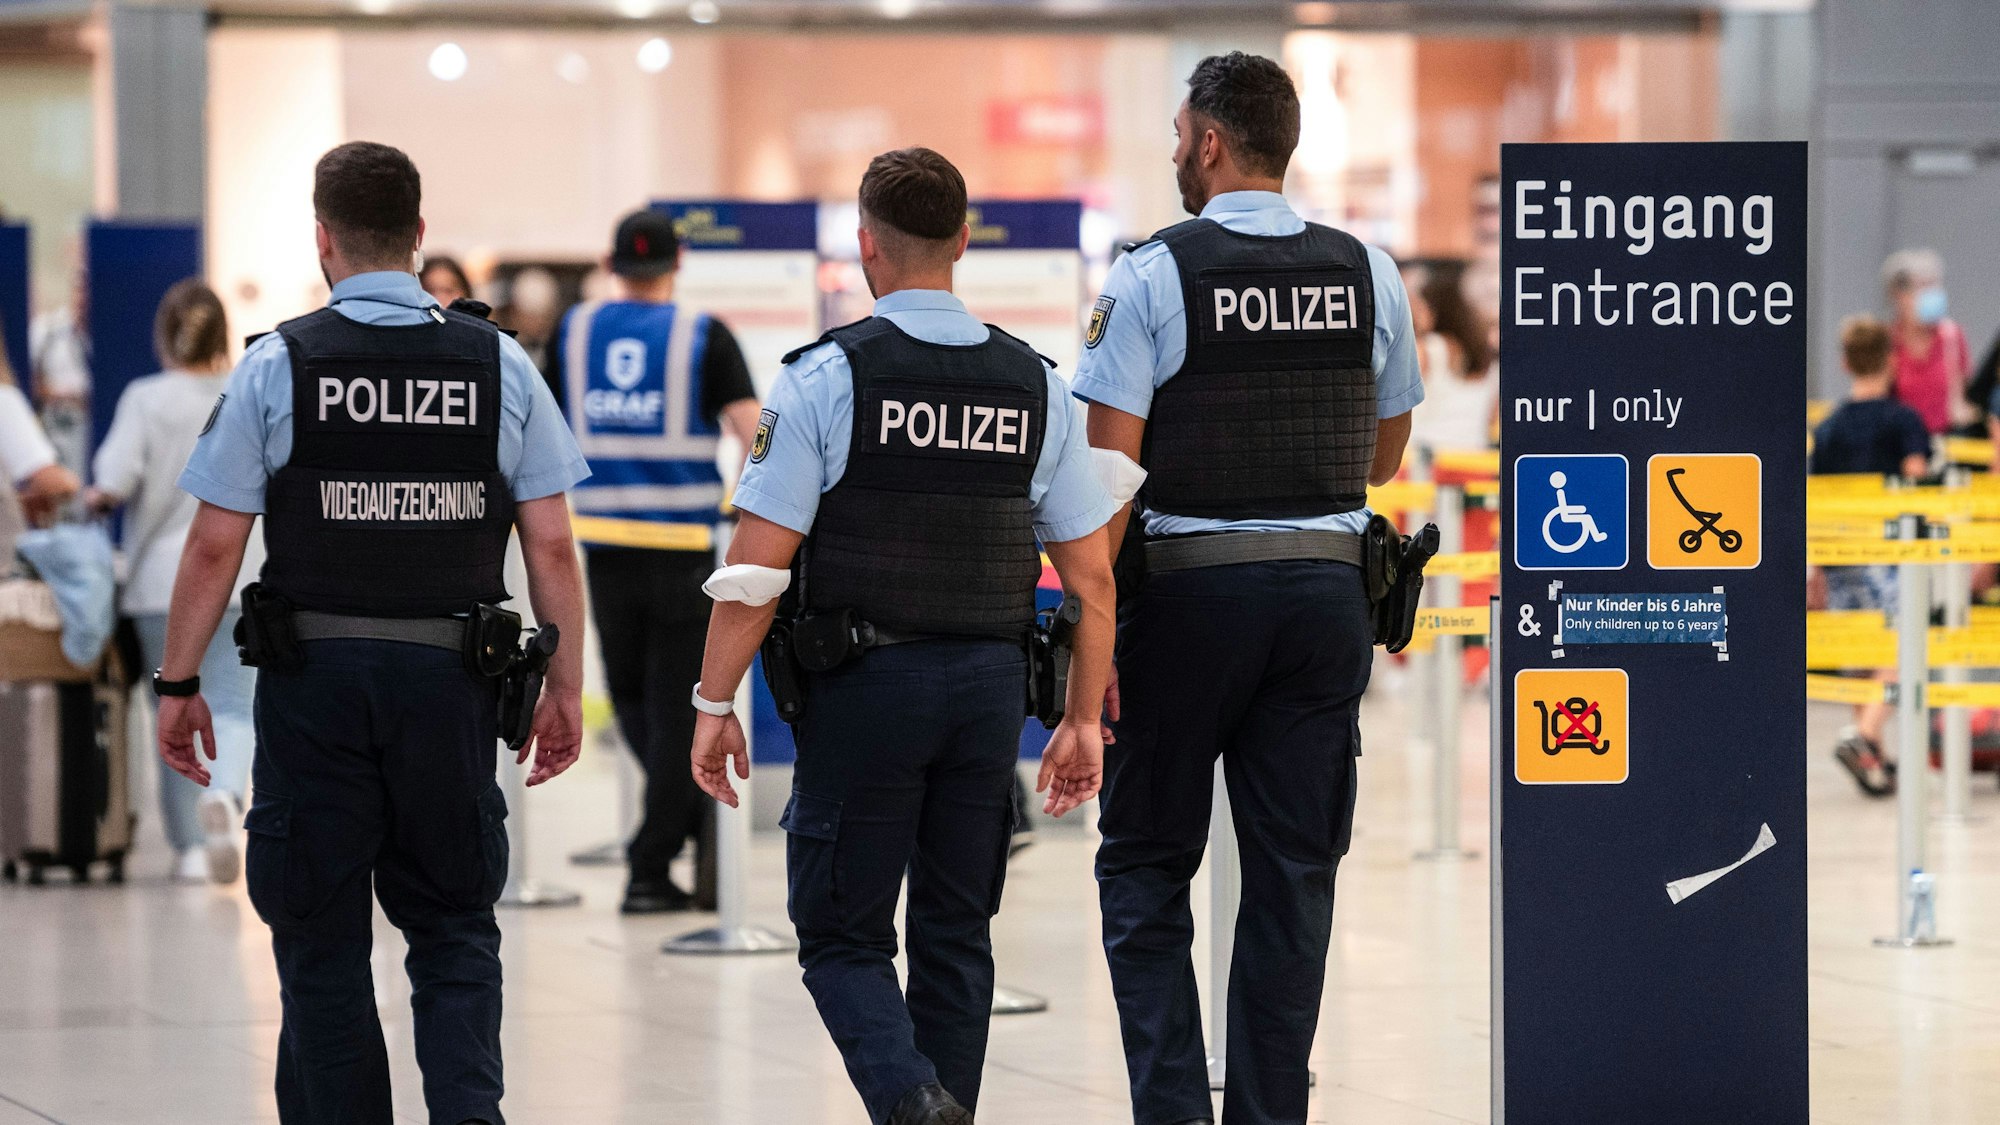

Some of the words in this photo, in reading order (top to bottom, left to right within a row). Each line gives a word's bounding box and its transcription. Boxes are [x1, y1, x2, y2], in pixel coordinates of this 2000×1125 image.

[1515, 180, 1774, 256] Eingang
[1213, 284, 1358, 332] POLIZEI
[1515, 266, 1795, 327] Entrance
[318, 377, 477, 426] POLIZEI
[1514, 397, 1573, 423] nur
[1612, 388, 1684, 429] only
[879, 399, 1029, 455] POLIZEI
[319, 479, 486, 521] VIDEOAUFZEICHNUNG
[1517, 603, 1542, 637] &
[1565, 617, 1592, 631] Only
[1594, 617, 1642, 630] children
[1644, 620, 1660, 632] up
[1662, 619, 1675, 631] to
[1678, 619, 1686, 631] 6
[1687, 620, 1719, 632] years
[1566, 598, 1593, 612] Nur
[1596, 598, 1644, 612] Kinder
[1647, 598, 1669, 612] bis
[1671, 599, 1681, 613] 6
[1683, 600, 1723, 613] Jahre
